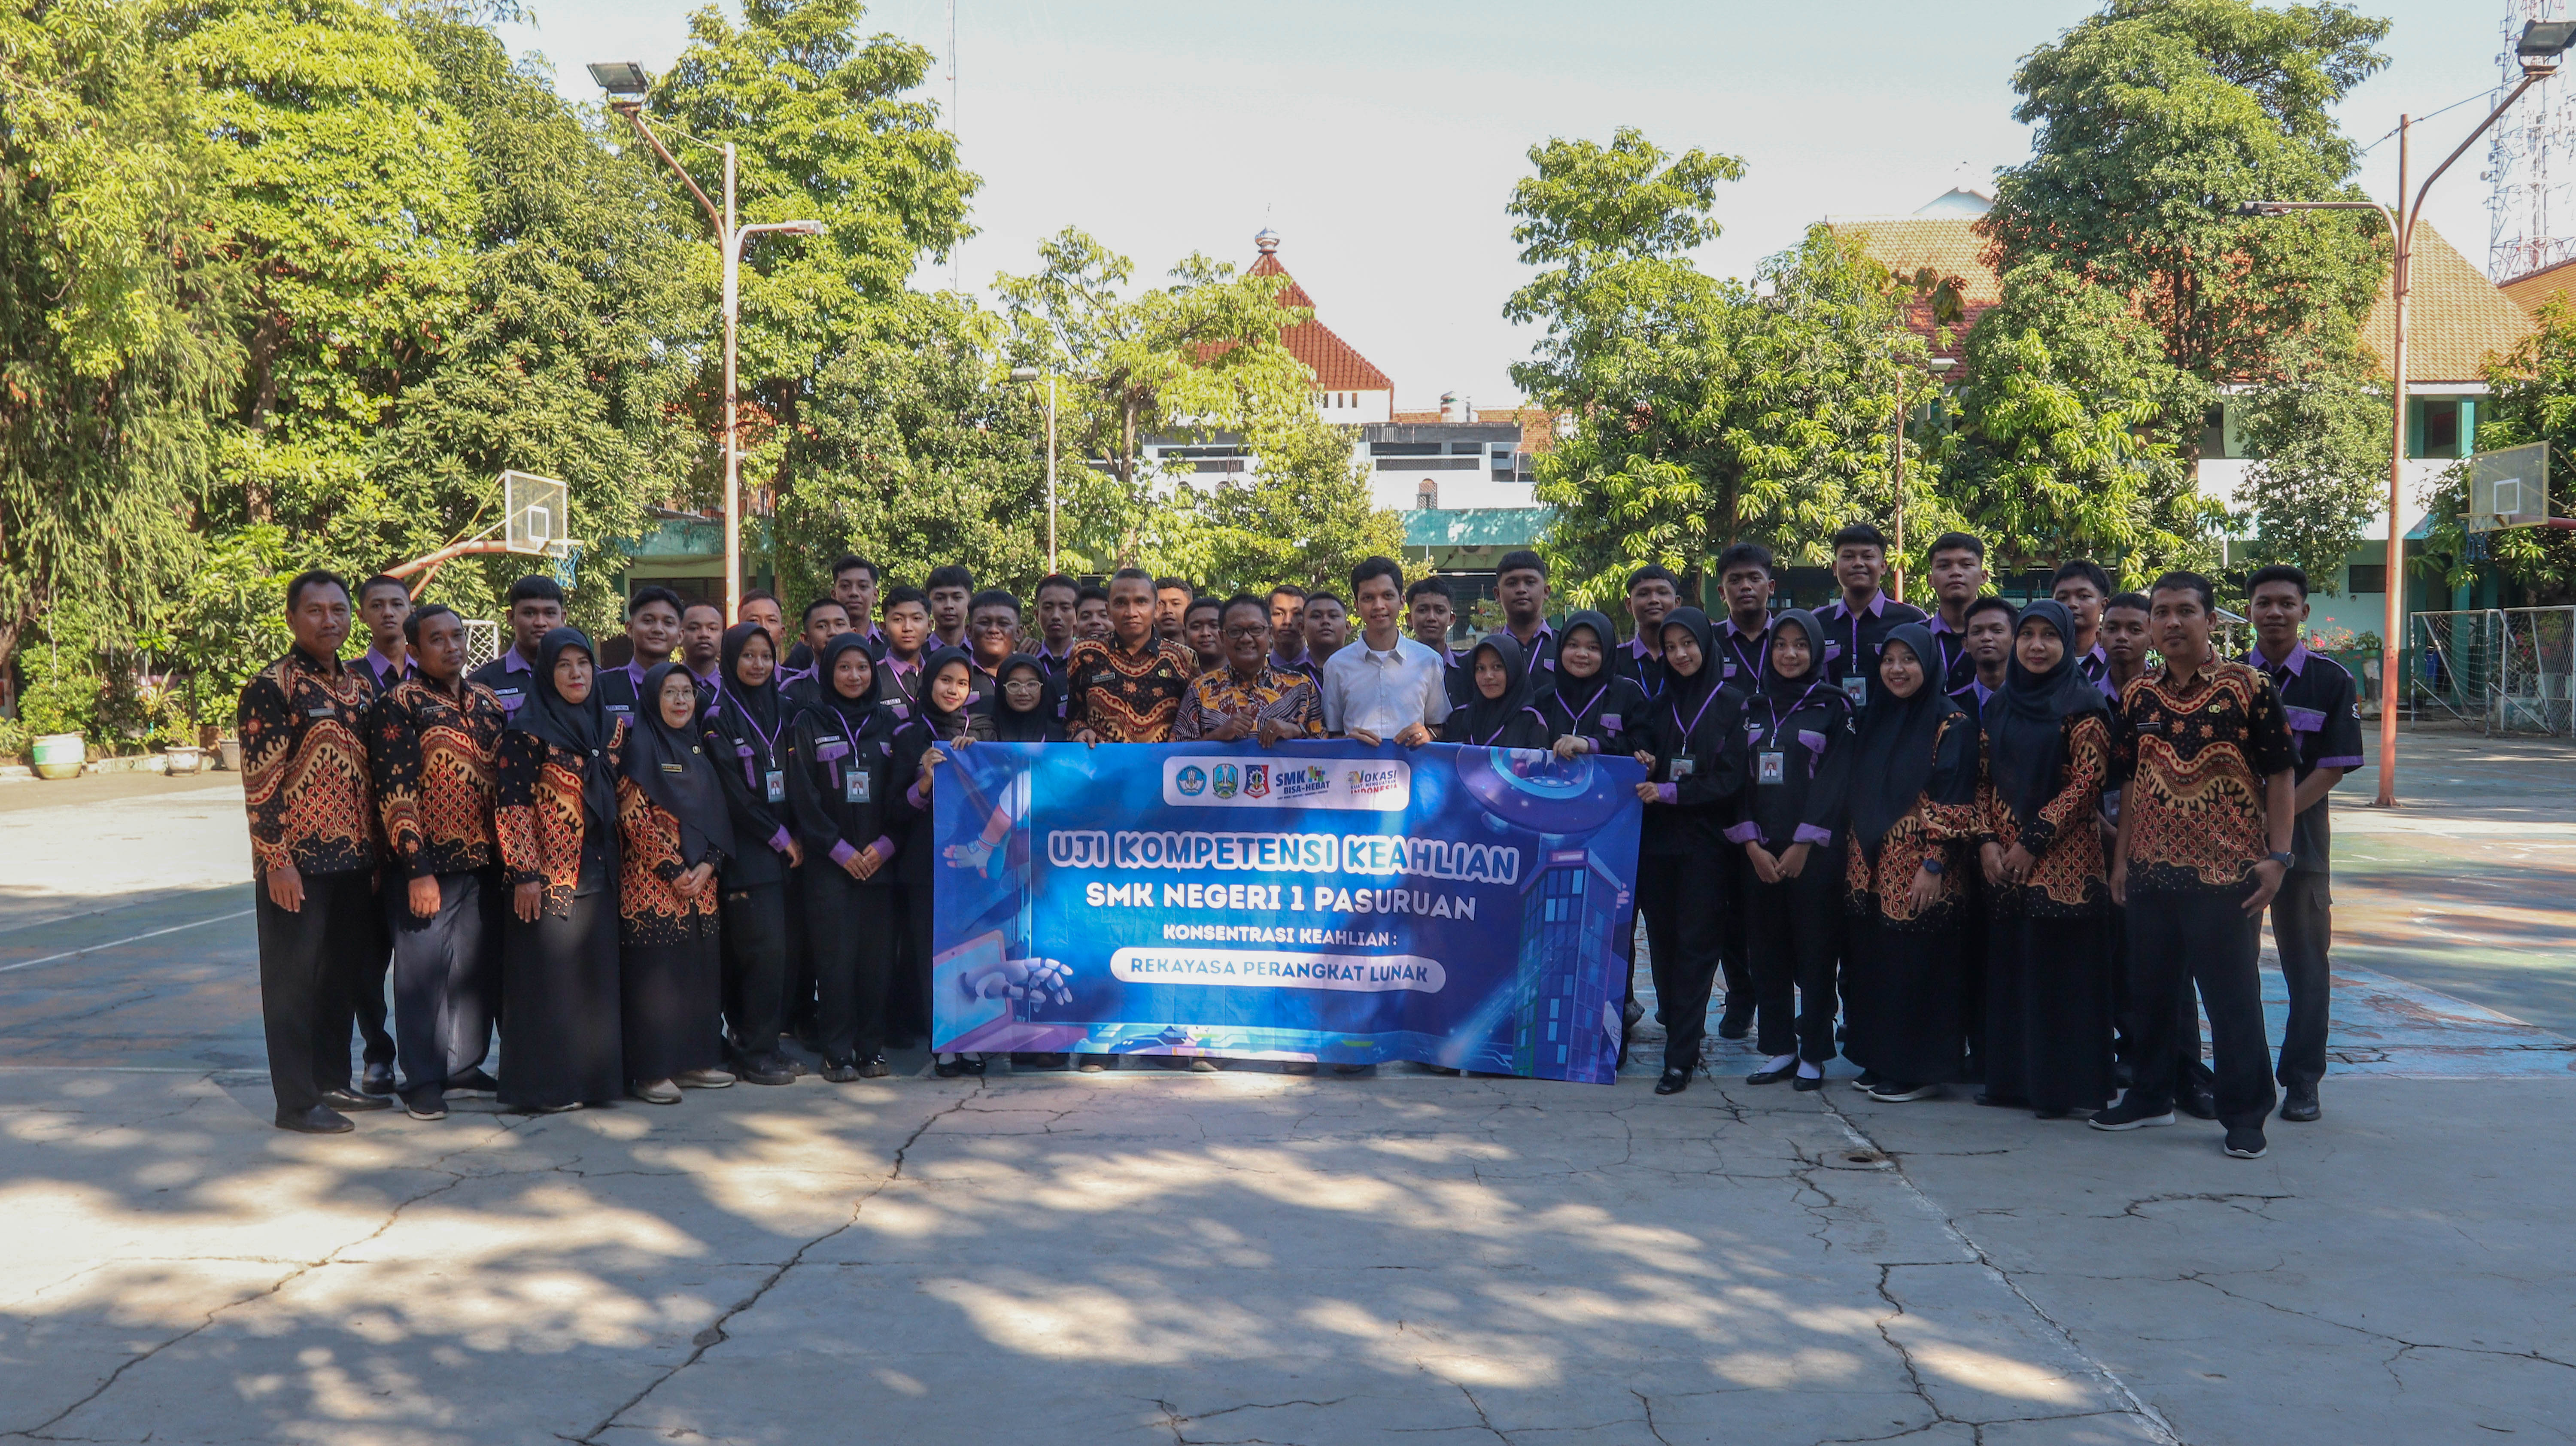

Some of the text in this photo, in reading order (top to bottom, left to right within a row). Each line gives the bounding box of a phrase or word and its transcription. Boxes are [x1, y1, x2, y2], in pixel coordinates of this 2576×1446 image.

[1276, 770, 1306, 787] SMK
[1284, 781, 1331, 795] BISA-HEBAT
[1051, 834, 1516, 881] UJI KOMPETENSI KEAHLIAN
[1086, 881, 1476, 921] SMK NEGERI 1 PASURUAN
[1163, 923, 1295, 943] KONSENTRASI
[1130, 957, 1428, 983] REKAYASA PERANGKAT LUNAK
